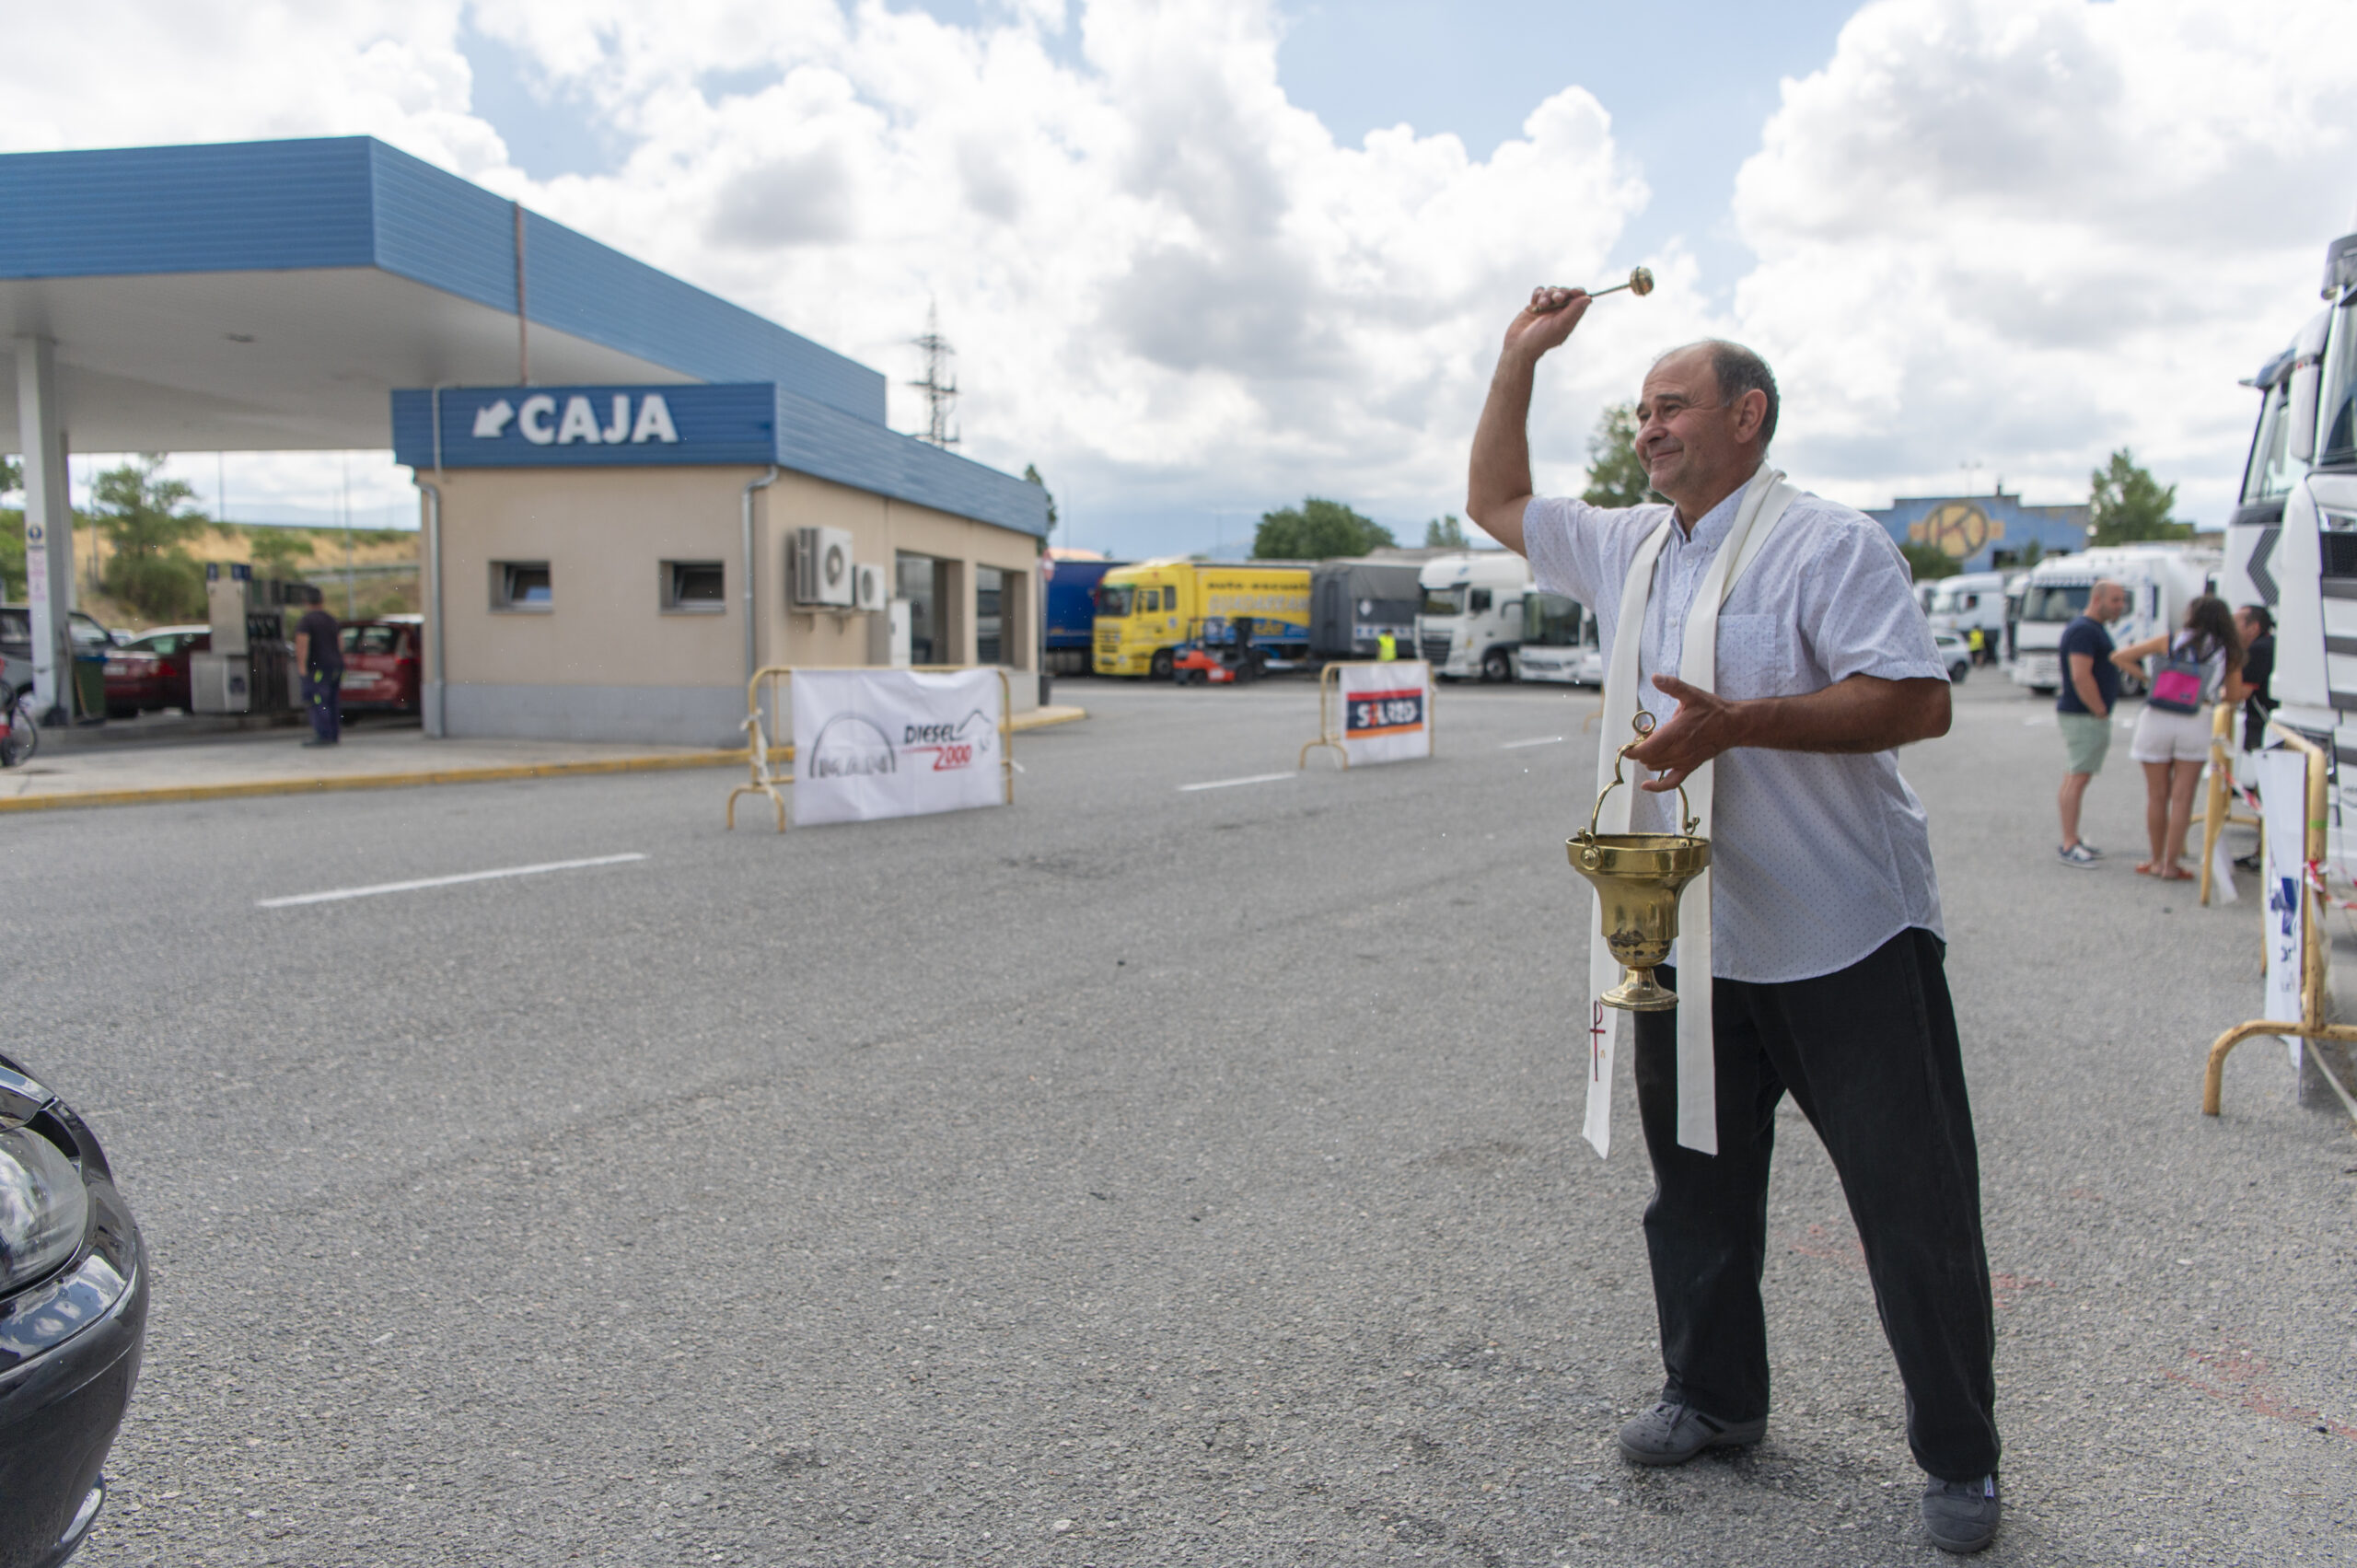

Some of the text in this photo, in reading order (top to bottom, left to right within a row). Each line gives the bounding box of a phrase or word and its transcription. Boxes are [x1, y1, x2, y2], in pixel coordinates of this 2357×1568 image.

[518, 393, 679, 445] CAJA
[904, 724, 961, 745] DIESEL
[932, 744, 972, 772] 2000
